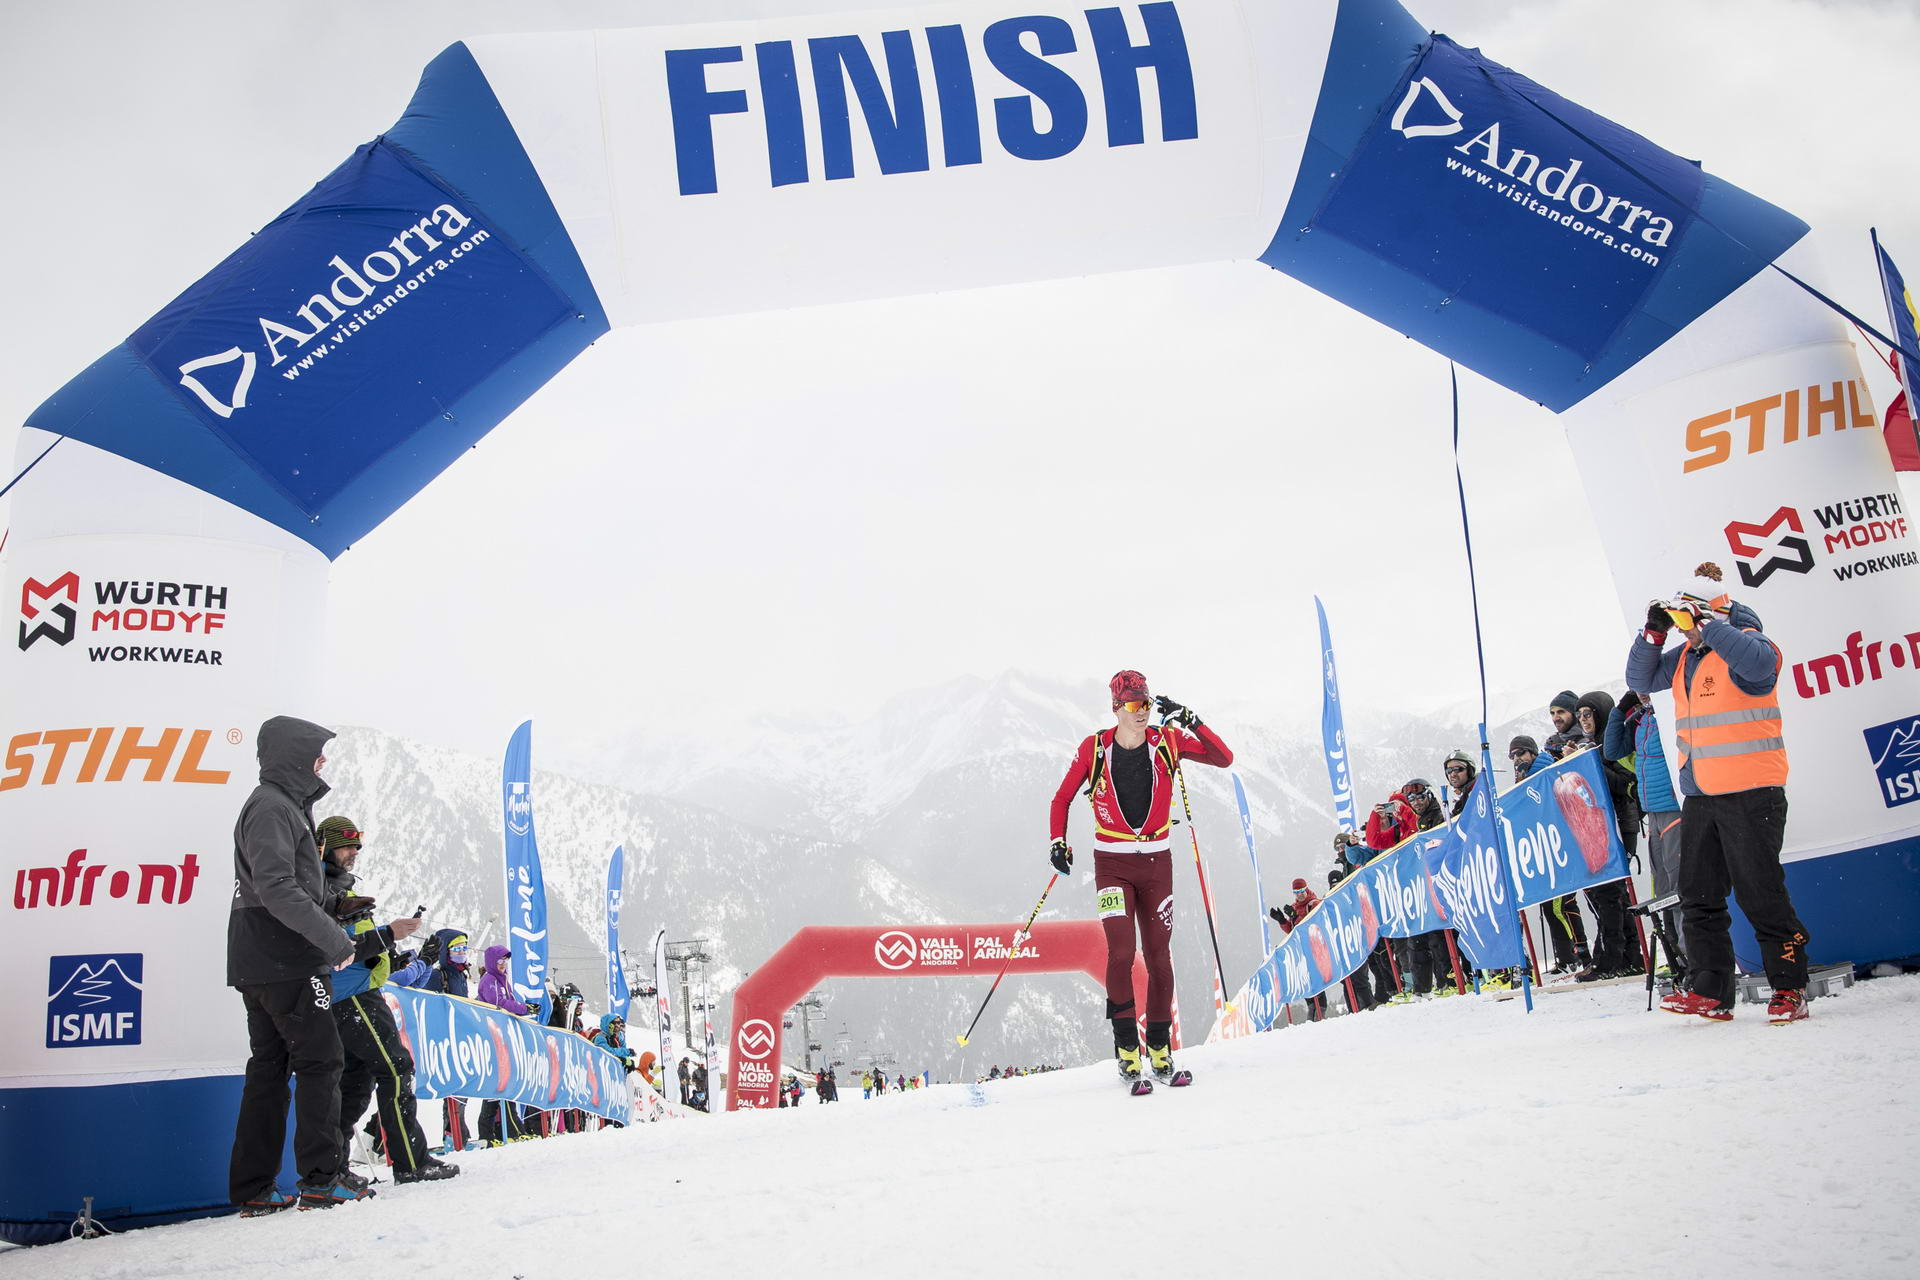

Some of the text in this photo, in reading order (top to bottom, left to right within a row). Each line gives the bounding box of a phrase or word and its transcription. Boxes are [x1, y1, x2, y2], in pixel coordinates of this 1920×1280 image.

[665, 1, 1198, 196] FINISH
[1454, 122, 1673, 247] Andorra
[1446, 157, 1659, 266] www.visitandorra.com
[259, 203, 473, 366] Andorra
[282, 228, 490, 381] www.visitandorra.com
[1683, 380, 1875, 473] STIHL
[1824, 518, 1908, 554] MODYF
[1833, 551, 1918, 581] WORKWEAR
[92, 608, 226, 634] MODYF
[88, 645, 223, 666] WORKWEAR
[0, 727, 231, 792] STIHL
[1886, 770, 1920, 801] IS
[1501, 810, 1568, 902] lene
[15, 849, 199, 909] infront
[1101, 896, 1119, 908] 201
[920, 938, 959, 949] VALL
[920, 949, 964, 960] NORD
[974, 937, 1004, 948] PAL
[52, 1014, 134, 1043] ISMF
[413, 997, 493, 1099] Marlene
[738, 1062, 771, 1073] VALL
[738, 1072, 774, 1083] NORD
[737, 1099, 755, 1107] PAL
